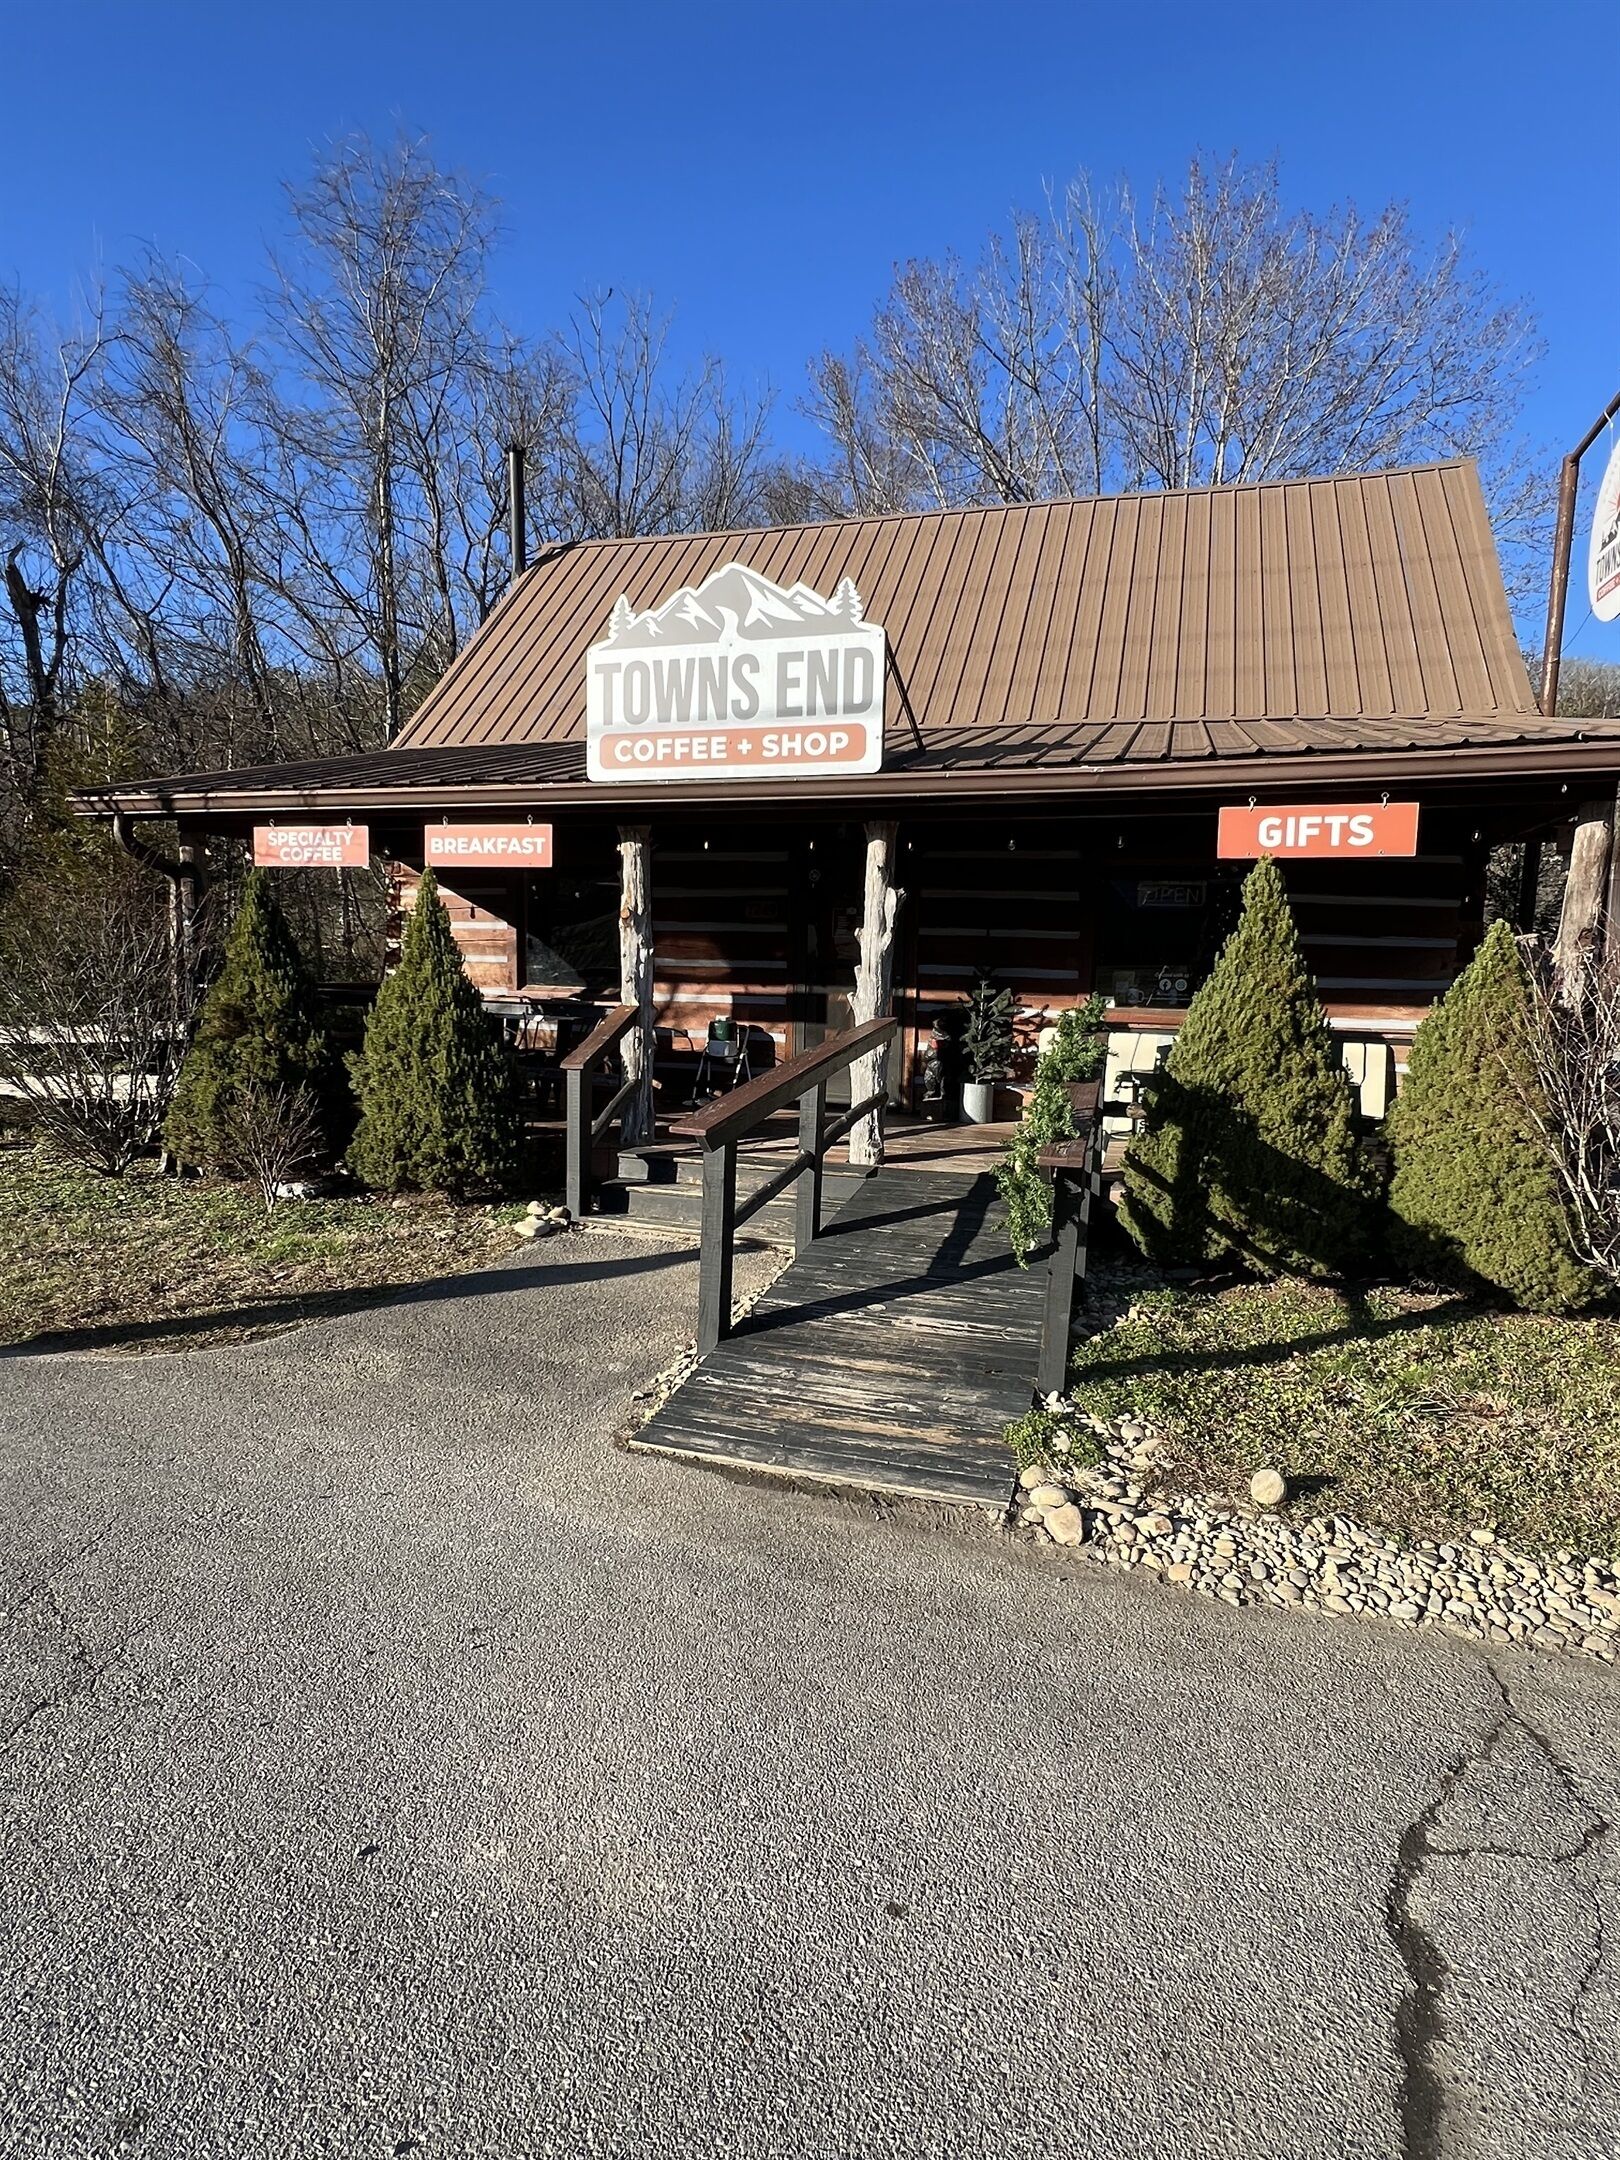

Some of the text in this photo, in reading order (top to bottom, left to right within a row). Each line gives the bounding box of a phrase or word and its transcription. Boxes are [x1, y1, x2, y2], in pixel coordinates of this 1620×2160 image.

[594, 646, 874, 726] TOWNS END
[614, 736, 727, 762] COFFEE
[762, 731, 849, 758] SHOP
[267, 831, 354, 846] SPECIALTY
[1258, 814, 1374, 848] GIFTS
[279, 846, 343, 862] COFFEE
[430, 837, 546, 854] BREAKFAST
[1146, 887, 1199, 903] OPEN
